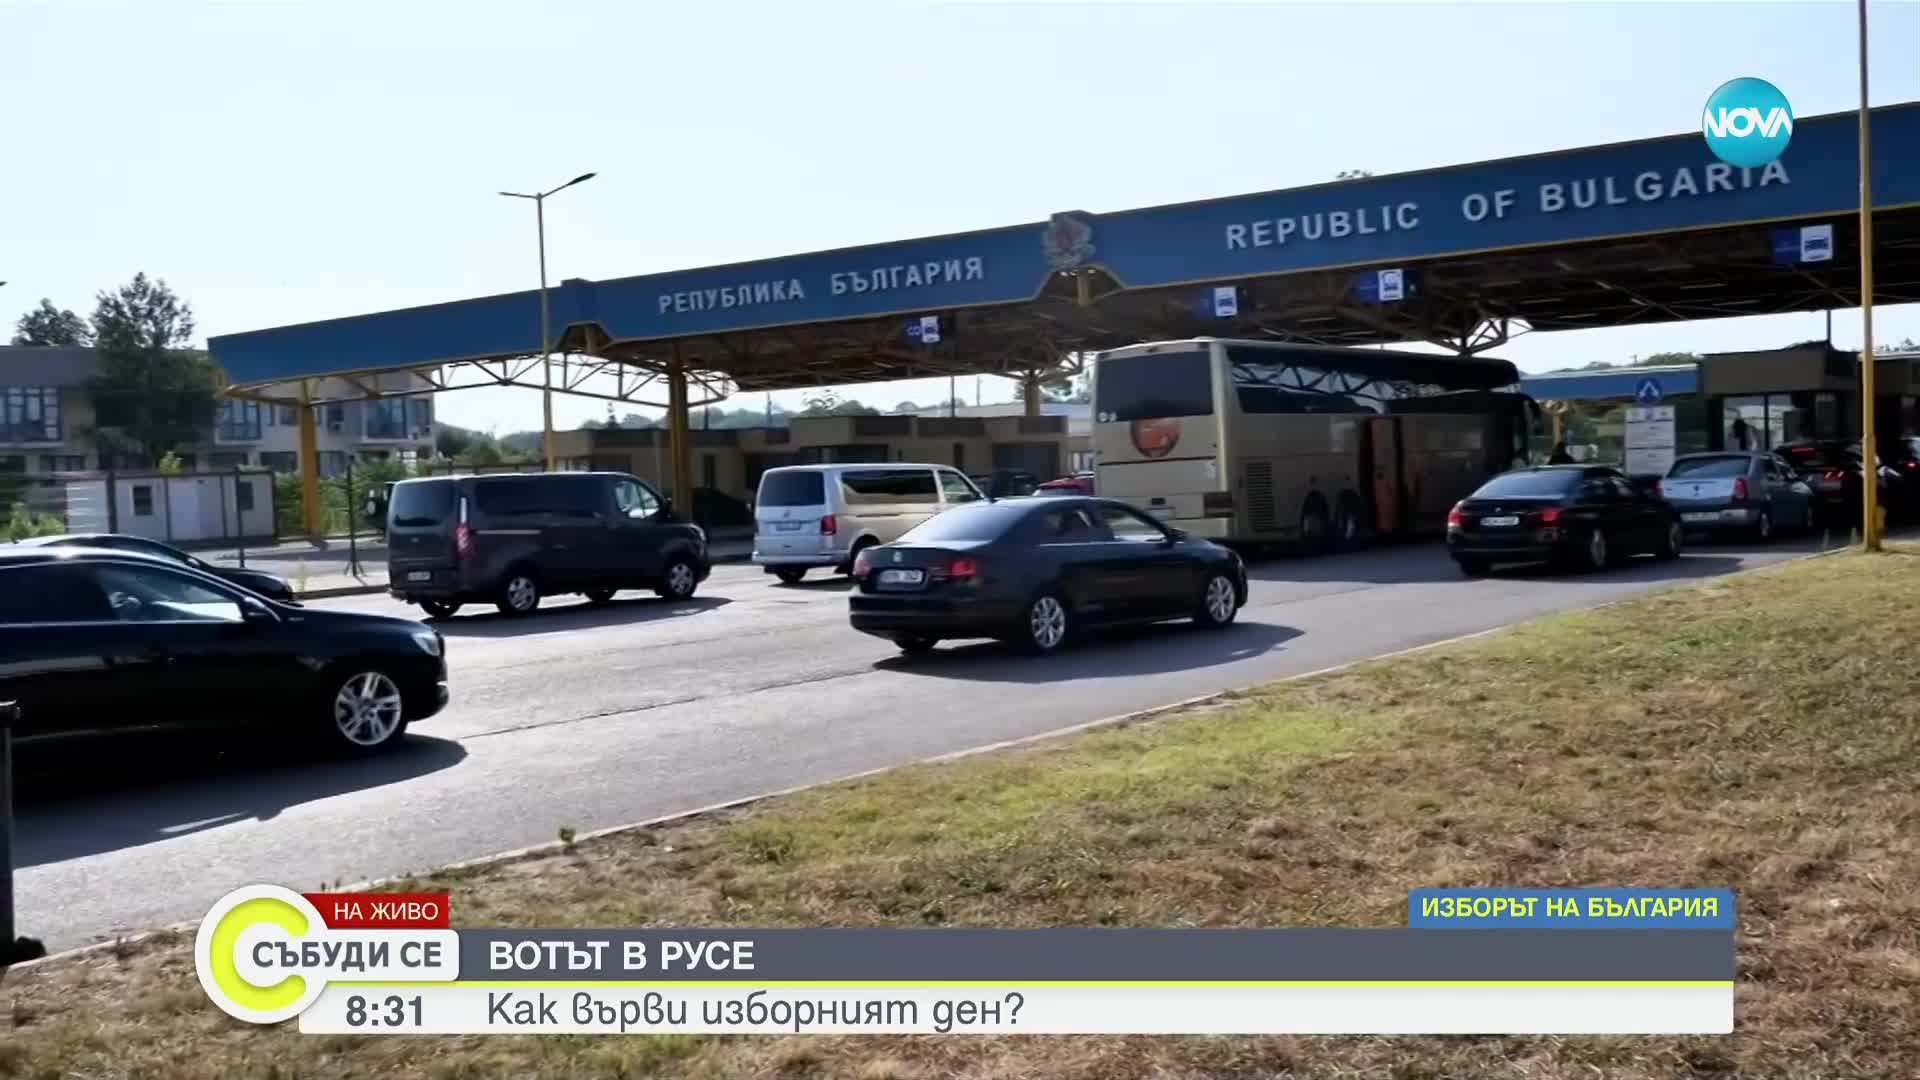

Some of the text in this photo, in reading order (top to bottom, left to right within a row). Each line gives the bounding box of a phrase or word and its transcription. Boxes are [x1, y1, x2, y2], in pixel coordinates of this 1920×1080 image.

[1227, 159, 1791, 251] REPUBLIC OF BULGARIA
[659, 256, 984, 314] РЕПУБЛИКА БЪЛГАРИЯ
